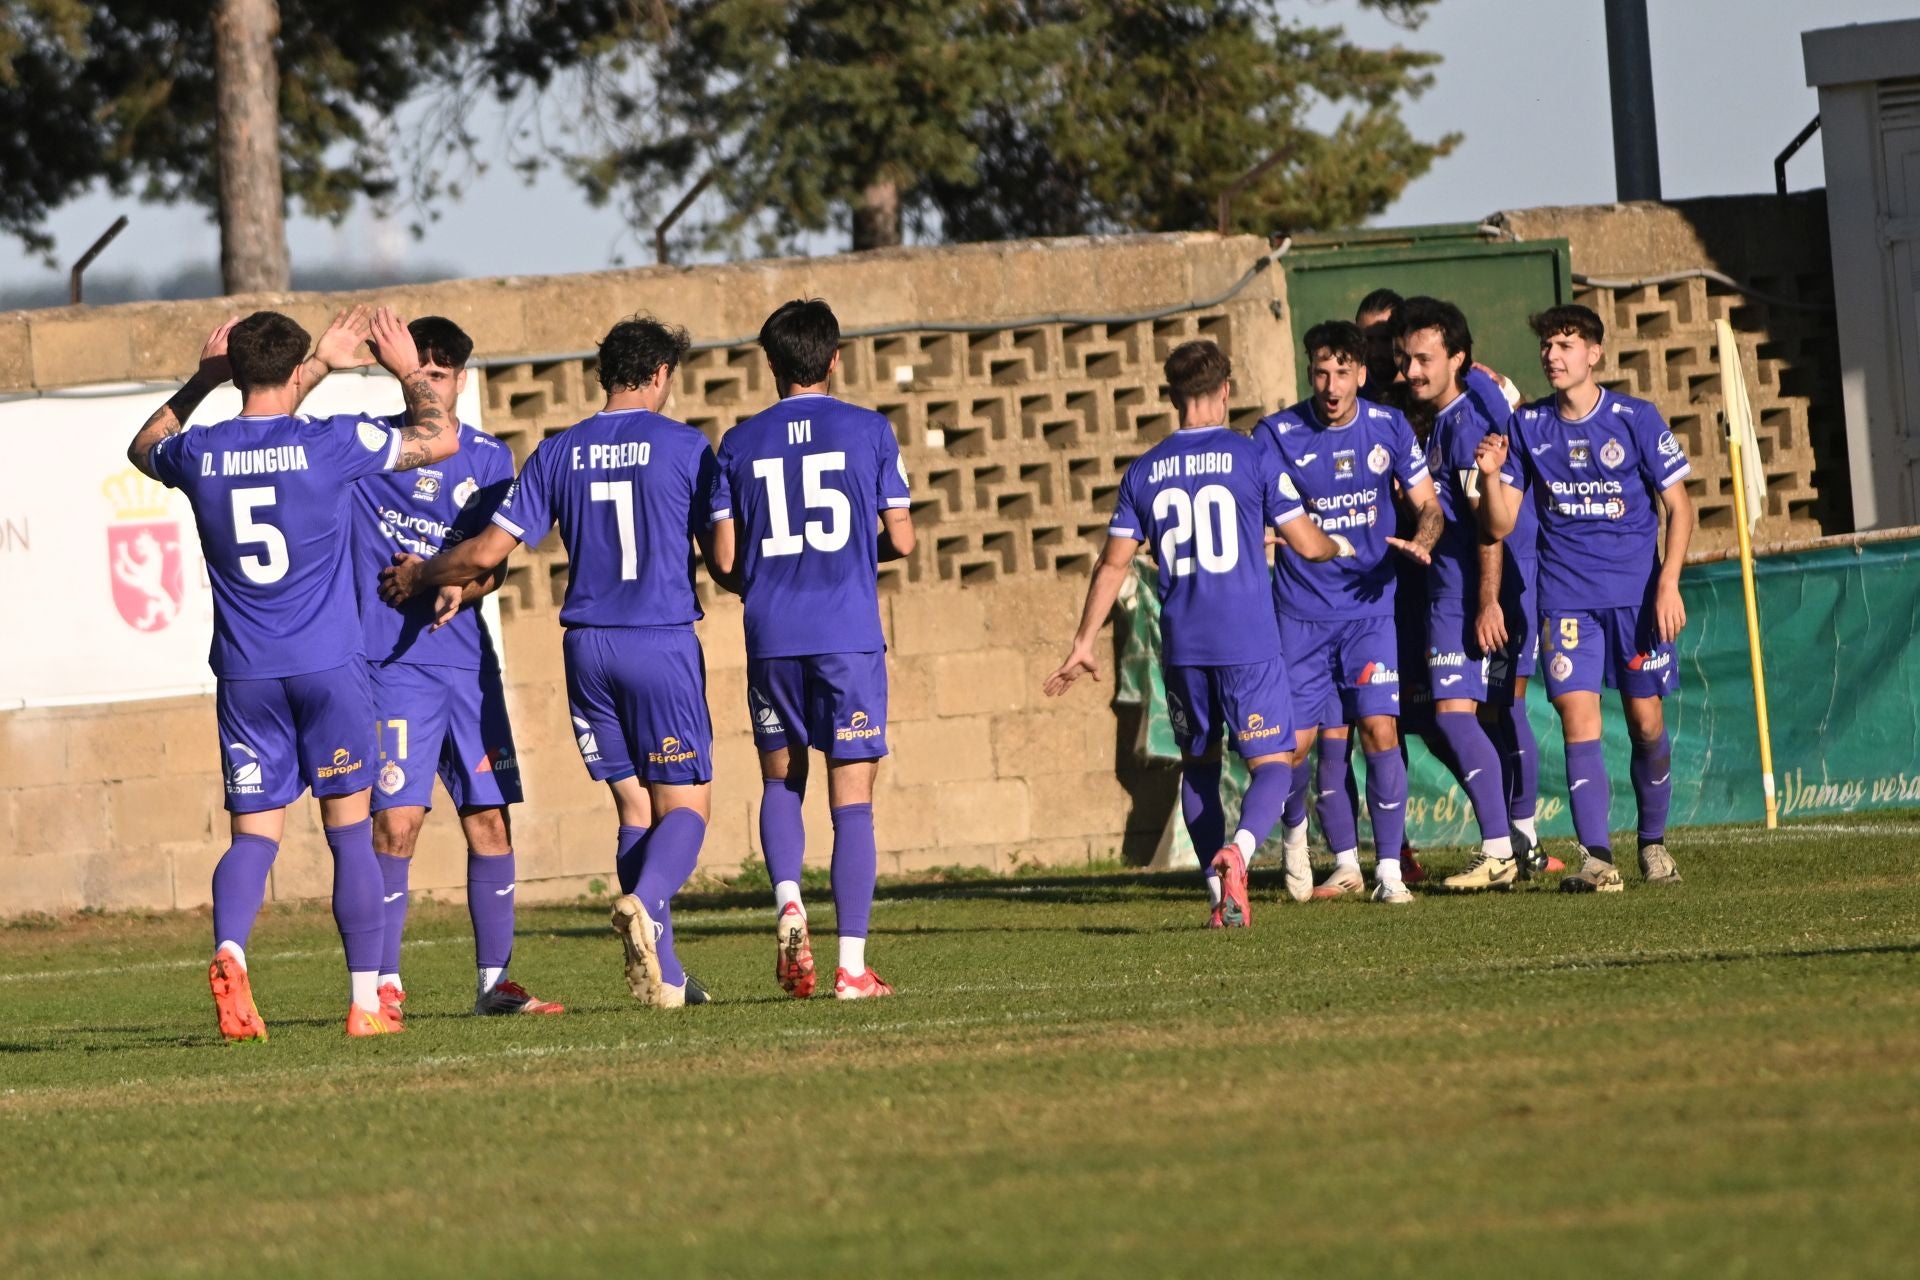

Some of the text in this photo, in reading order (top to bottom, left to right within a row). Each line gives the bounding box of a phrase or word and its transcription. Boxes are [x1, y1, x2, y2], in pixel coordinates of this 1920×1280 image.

[787, 419, 812, 445] IVI
[201, 445, 309, 477] D. MUNGUIA
[572, 441, 651, 470] F. PEREDO
[1148, 451, 1233, 484] JAVI RUBIO
[1551, 478, 1623, 495] euronics
[753, 451, 851, 557] 15
[230, 485, 290, 584] 5
[590, 480, 638, 581] 7
[1152, 484, 1240, 577] 20
[836, 725, 881, 741] agropal
[317, 759, 362, 778] agropal
[649, 750, 696, 764] agropal
[241, 785, 265, 794] BELL
[1433, 784, 1459, 822] el
